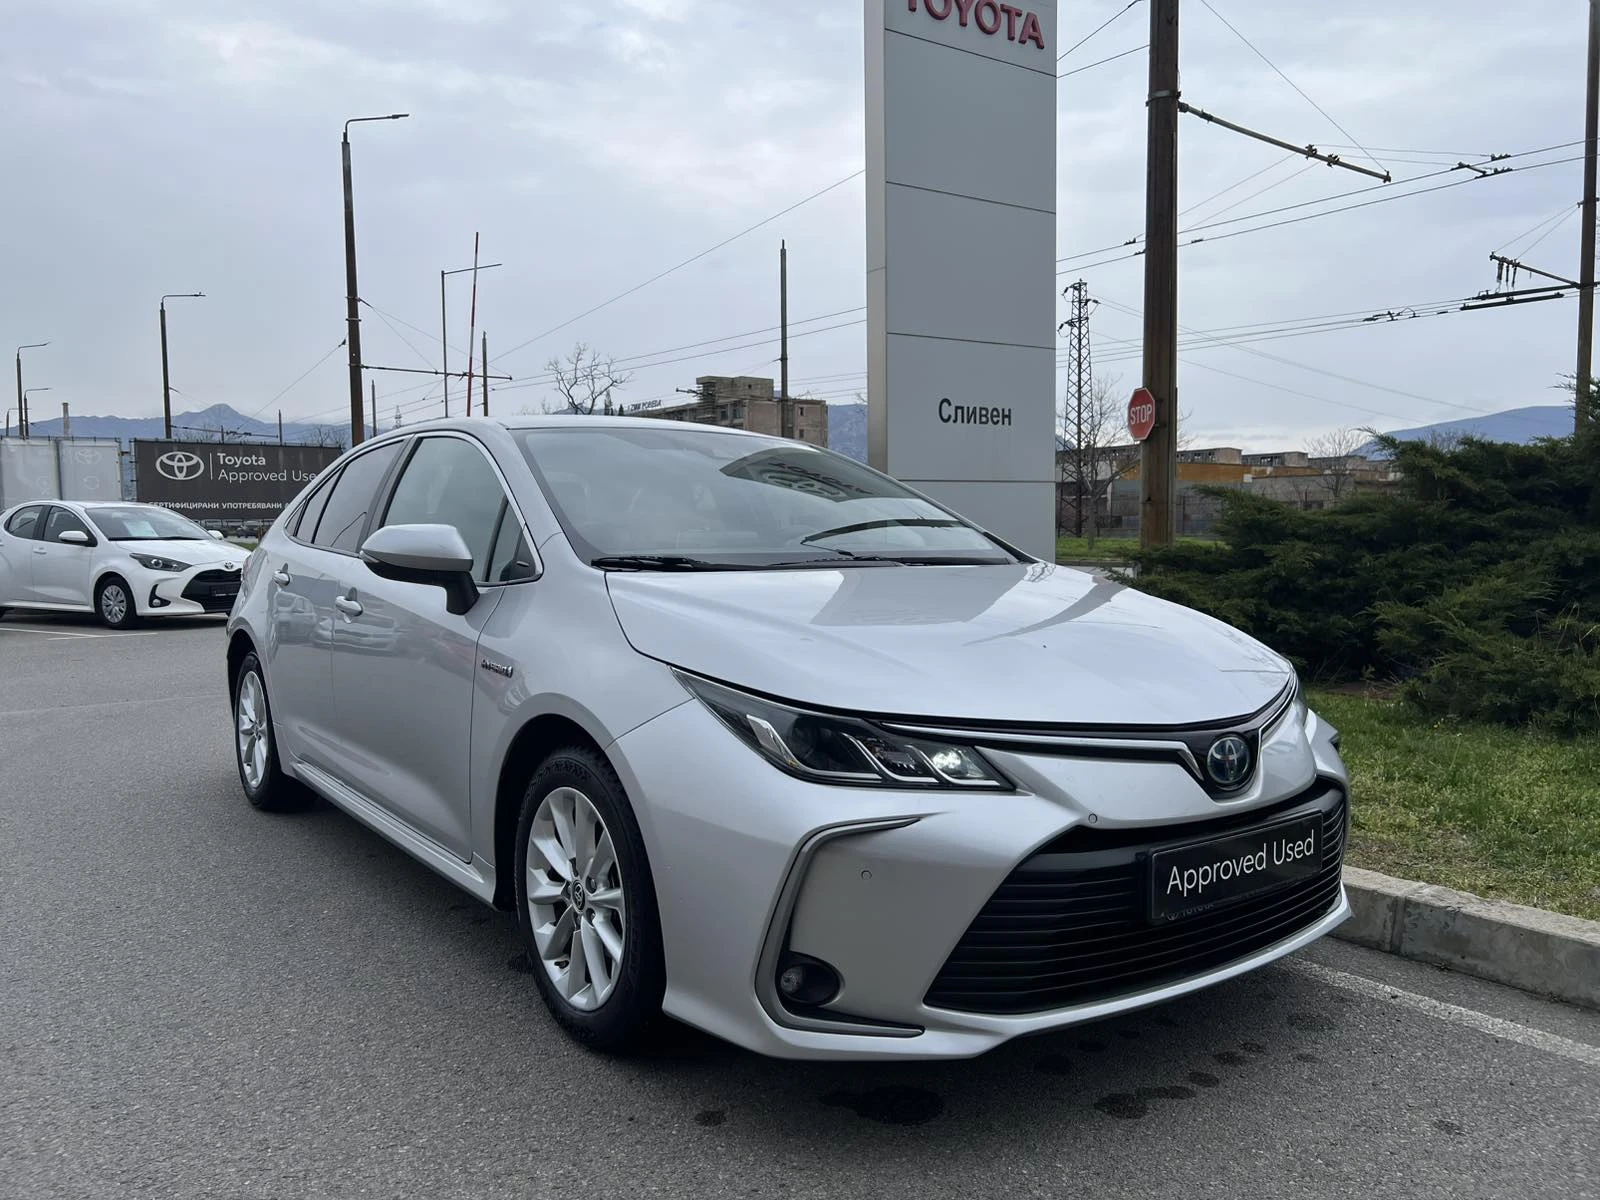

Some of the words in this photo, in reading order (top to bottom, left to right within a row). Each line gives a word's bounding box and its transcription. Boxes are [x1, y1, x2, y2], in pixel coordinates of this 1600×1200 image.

[939, 398, 1011, 426] Сливен
[1130, 404, 1153, 425] STOP
[217, 453, 266, 467] Toyota
[218, 469, 287, 483] Approved
[1166, 842, 1267, 898] Approved
[1273, 828, 1315, 866] Used
